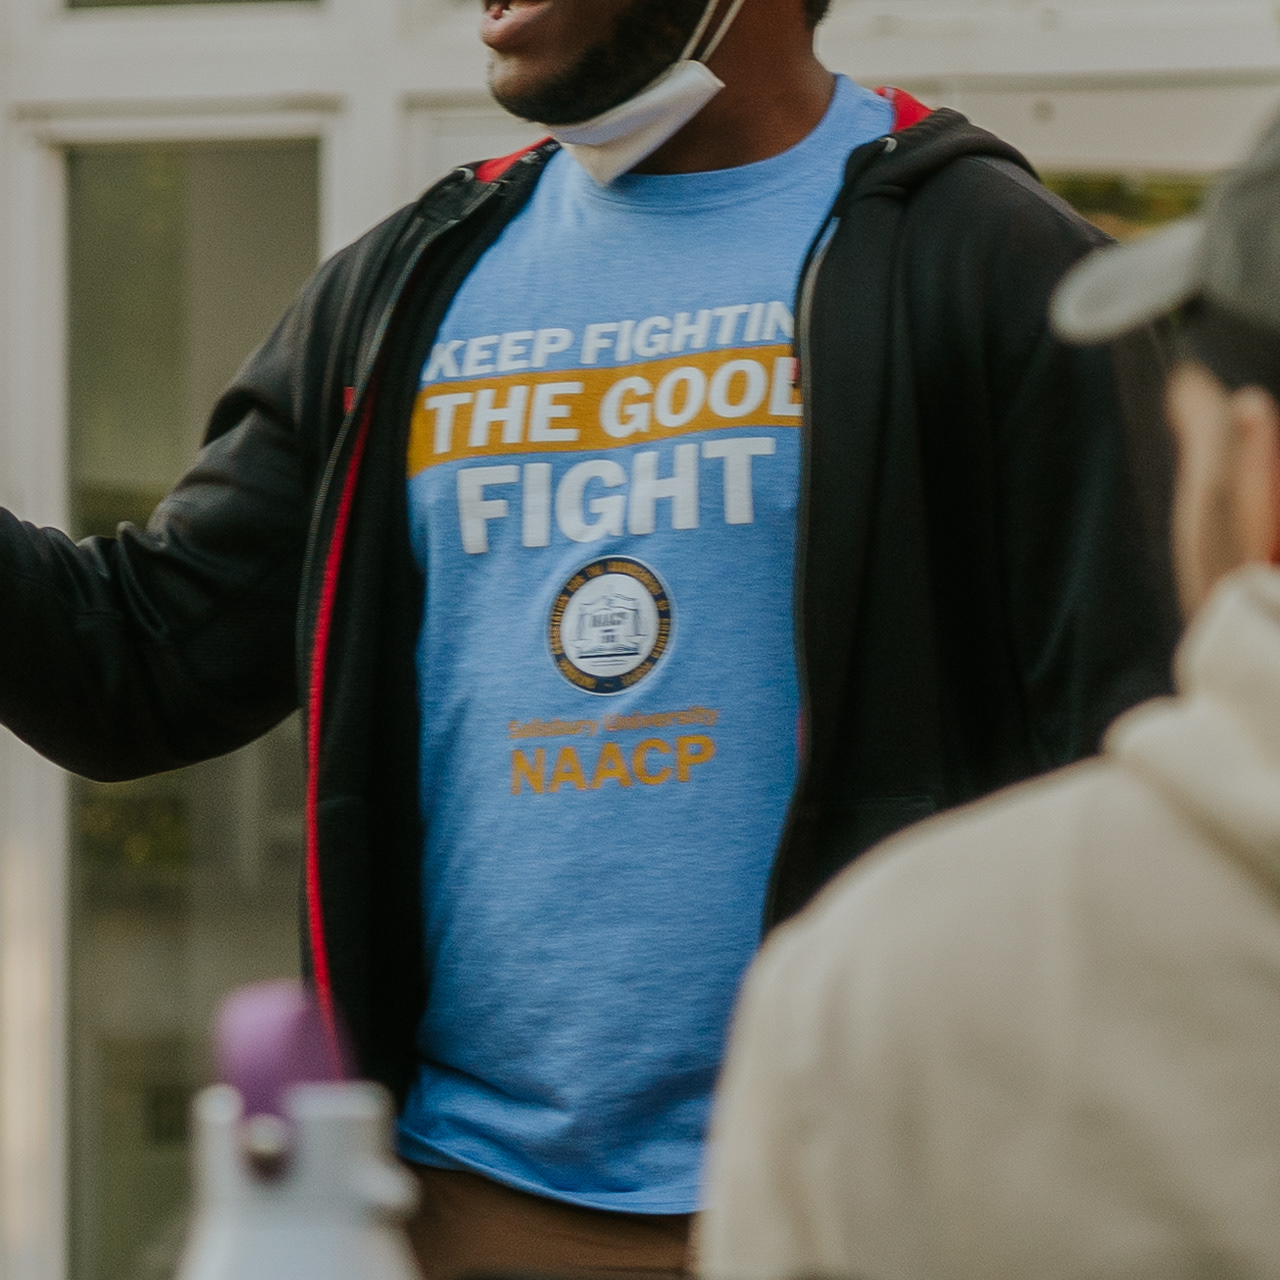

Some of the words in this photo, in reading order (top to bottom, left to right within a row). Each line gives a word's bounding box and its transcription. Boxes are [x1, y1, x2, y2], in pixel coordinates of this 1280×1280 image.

[422, 327, 574, 382] KEEP
[579, 300, 795, 366] FIGHTIN
[424, 381, 584, 455] THE
[457, 437, 776, 555] FIGHT
[510, 733, 718, 796] NAACP
